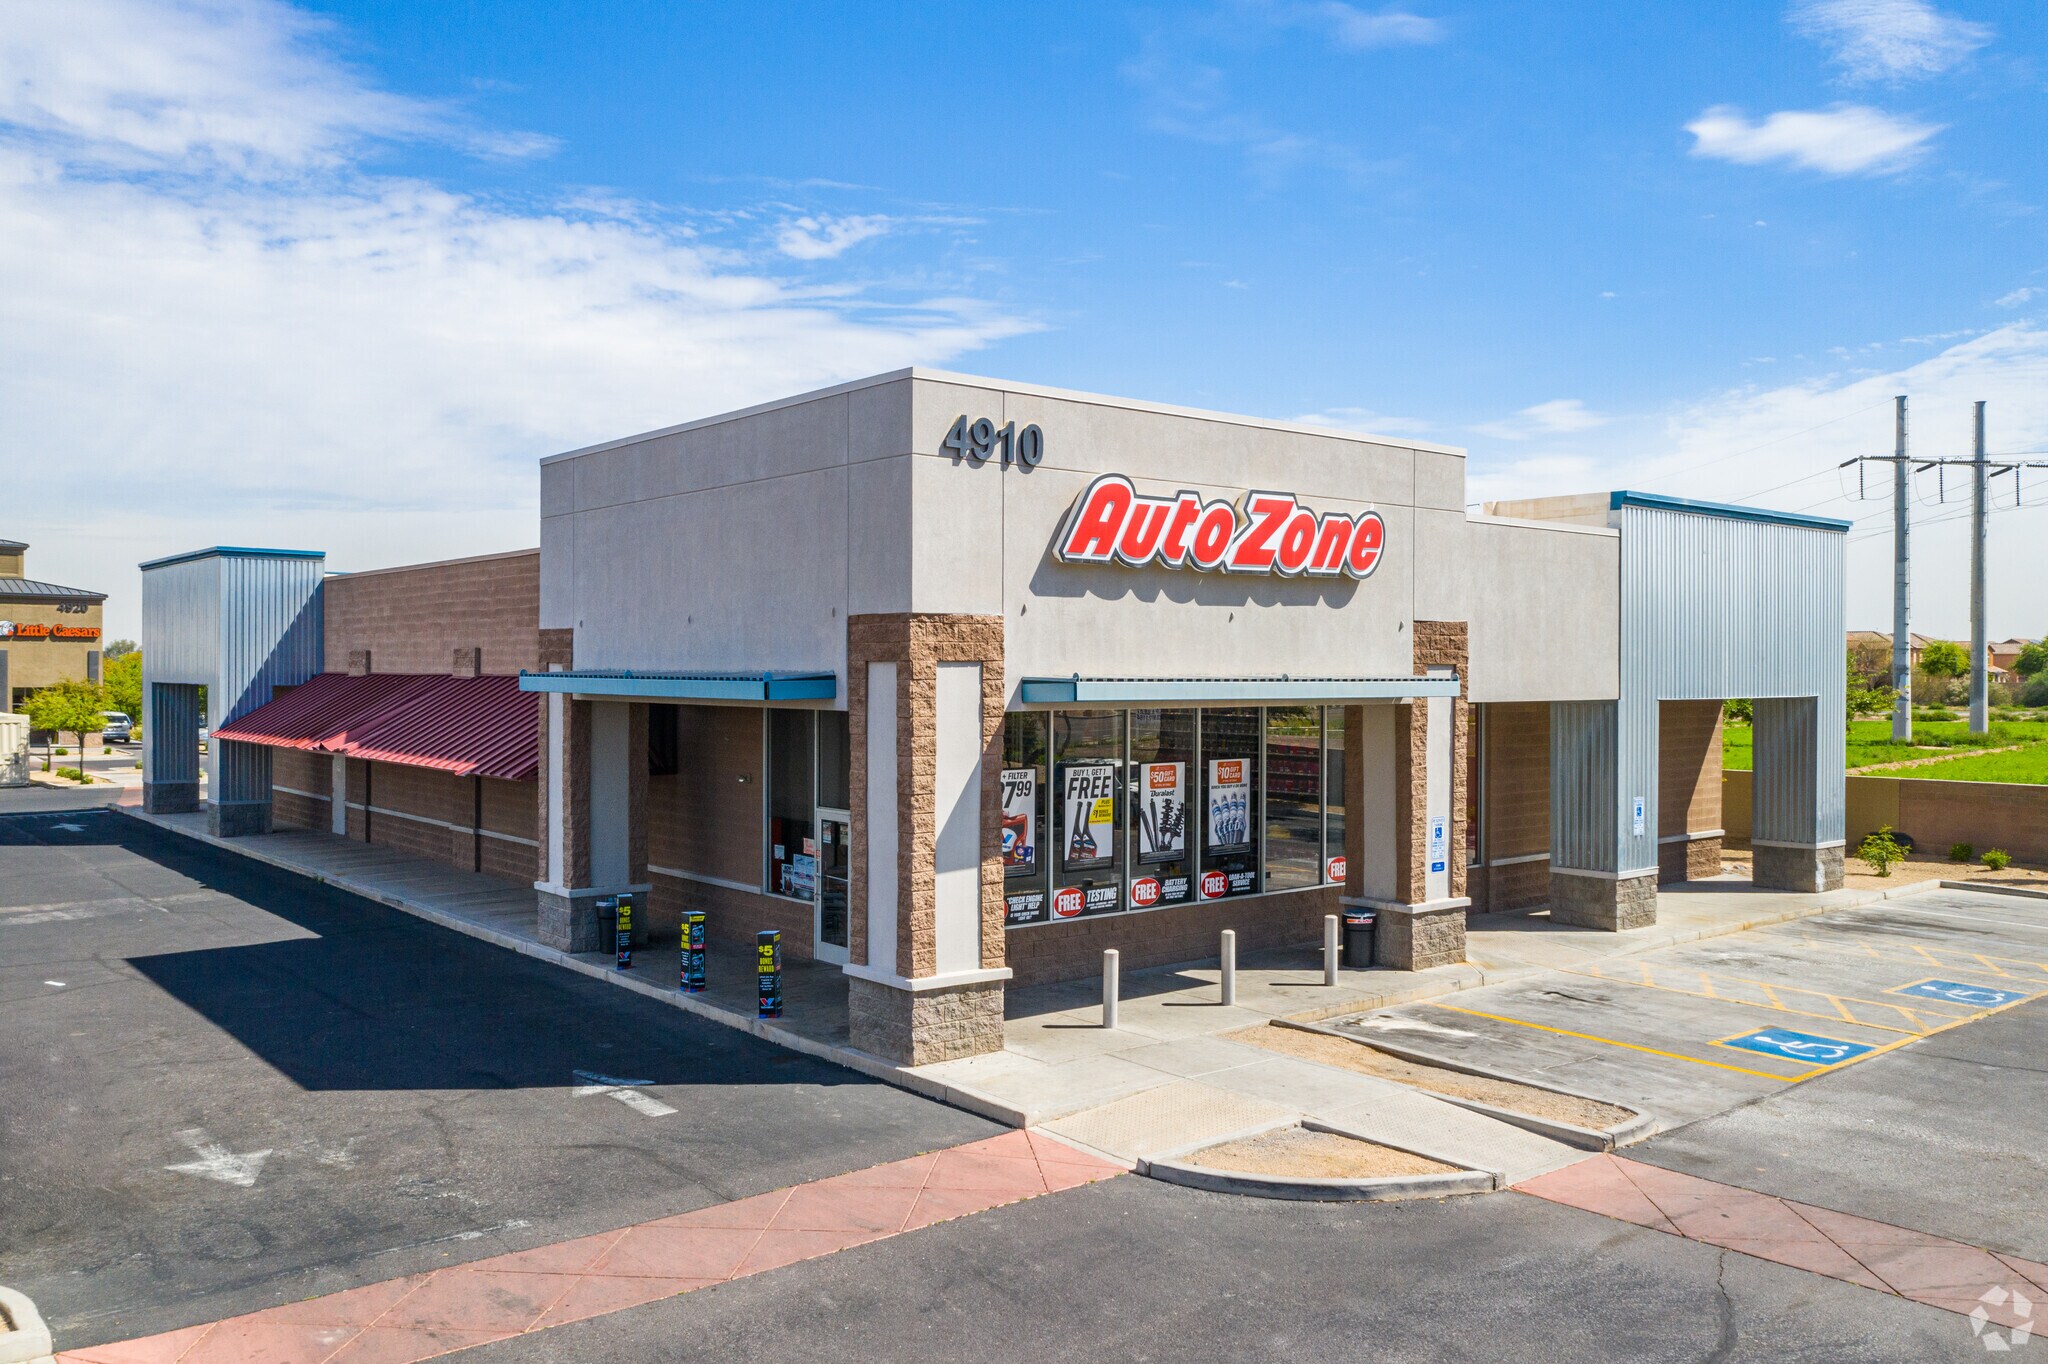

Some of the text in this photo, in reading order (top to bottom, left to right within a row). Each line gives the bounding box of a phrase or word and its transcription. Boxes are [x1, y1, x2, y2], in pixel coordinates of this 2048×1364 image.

[945, 414, 1044, 466] 4910
[1060, 477, 1385, 576] AutoZone
[56, 602, 89, 614] 4920
[16, 623, 100, 638] Little Caesars
[1008, 772, 1028, 780] FILTER
[1150, 771, 1164, 782] $50
[1218, 766, 1230, 779] $10
[1067, 776, 1111, 800] FREE
[1165, 878, 1187, 886] BATTERY
[1204, 876, 1224, 894] FREE
[1086, 887, 1117, 902] TESTING
[1136, 883, 1156, 900] FREE
[1162, 884, 1188, 893] CHARGING
[1026, 894, 1043, 902] ENGINE
[1058, 893, 1081, 912] FREE
[618, 906, 631, 916] $5
[681, 923, 690, 934] $5
[758, 945, 773, 956] $5
